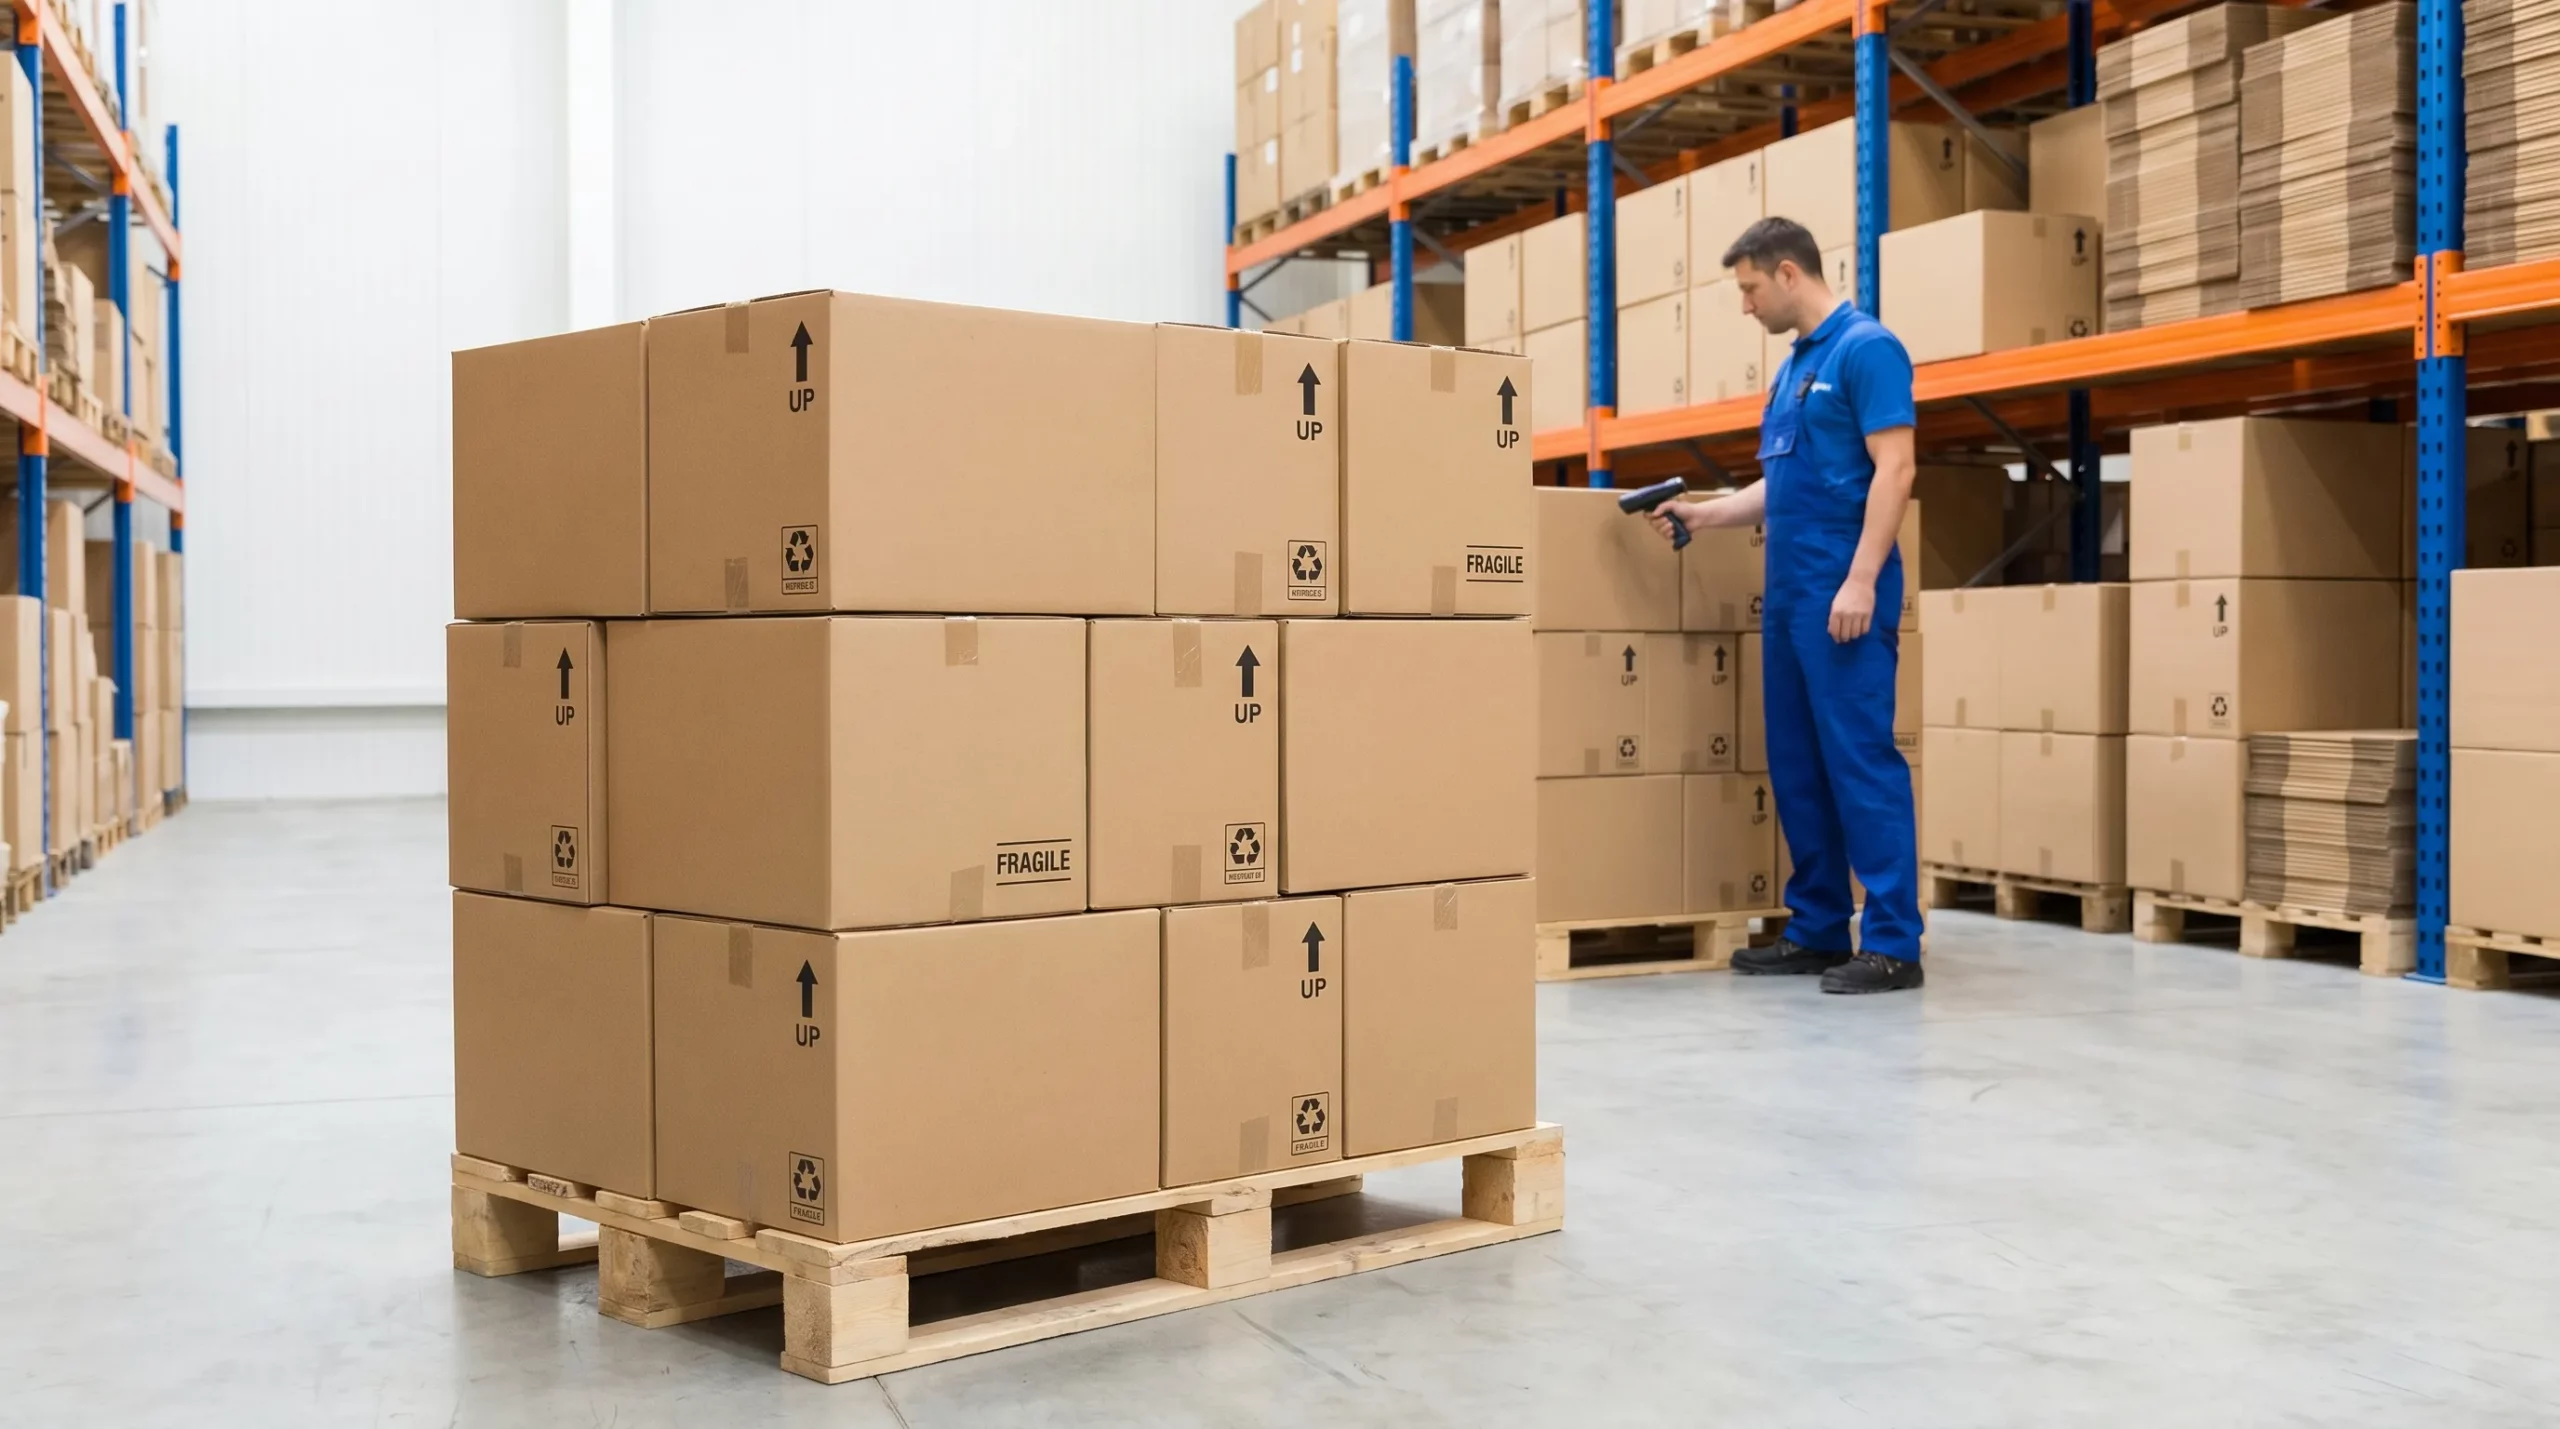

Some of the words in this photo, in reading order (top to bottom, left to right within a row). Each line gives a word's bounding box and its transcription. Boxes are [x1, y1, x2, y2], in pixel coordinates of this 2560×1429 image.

[789, 388, 814, 412] UP
[1296, 420, 1323, 441] UP
[1497, 429, 1520, 449] UP
[1467, 554, 1523, 574] FRAGILE
[2213, 626, 2228, 638] UP
[1621, 674, 1638, 686] UP
[1712, 673, 1728, 686] UP
[556, 705, 575, 726] UP
[1235, 703, 1261, 724] UP
[1752, 813, 1767, 826] UP
[997, 849, 1070, 875] FRAGILE
[1301, 978, 1326, 999] UP
[796, 1023, 821, 1048] UP
